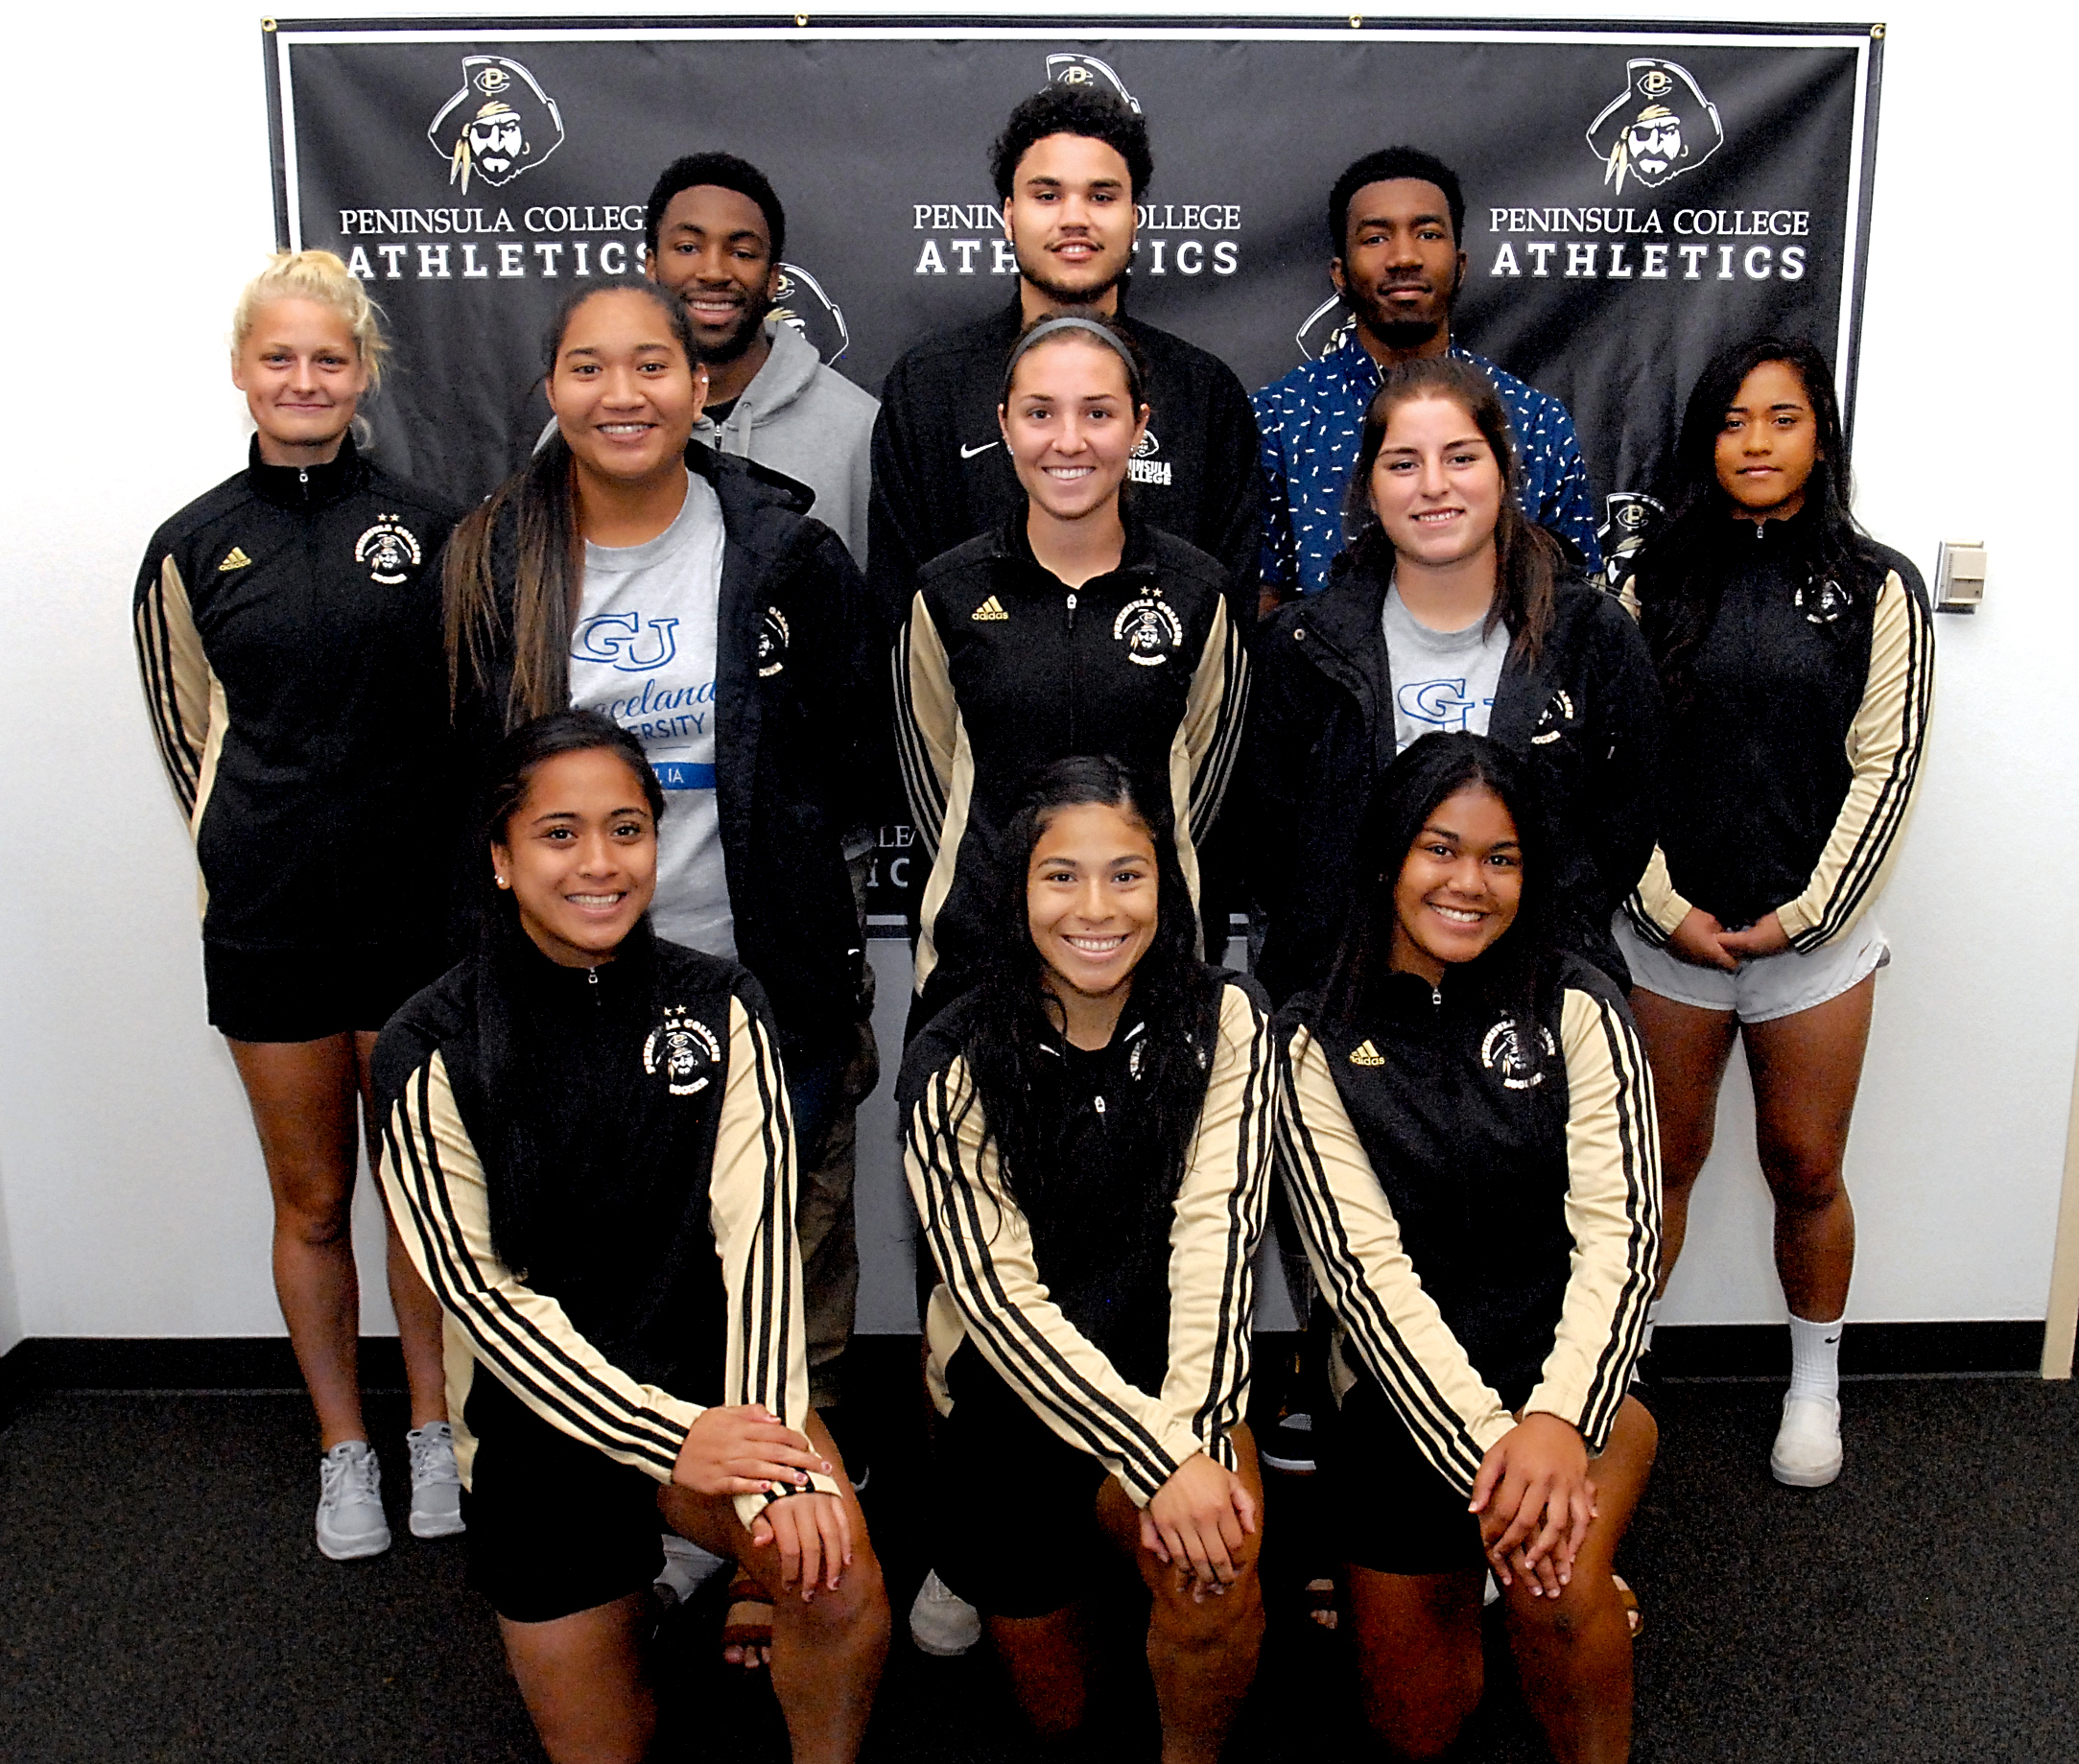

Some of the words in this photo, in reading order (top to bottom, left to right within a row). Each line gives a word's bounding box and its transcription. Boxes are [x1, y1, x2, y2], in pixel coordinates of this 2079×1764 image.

[339, 208, 515, 235] PENINSULA
[524, 205, 647, 232] COLLEG
[913, 204, 1005, 229] PENIN
[1137, 204, 1241, 230] LLEGE
[1489, 207, 1664, 233] PENINSULA
[1673, 208, 1809, 236] COLLEGE
[913, 239, 1240, 276] ATHICS
[1489, 242, 1807, 280] ATHLETICS
[1126, 470, 1172, 485] LLEGE
[1128, 459, 1171, 476] INSULA
[971, 611, 1009, 621] adidas
[626, 712, 706, 741] ERSITY
[669, 767, 685, 784] IA
